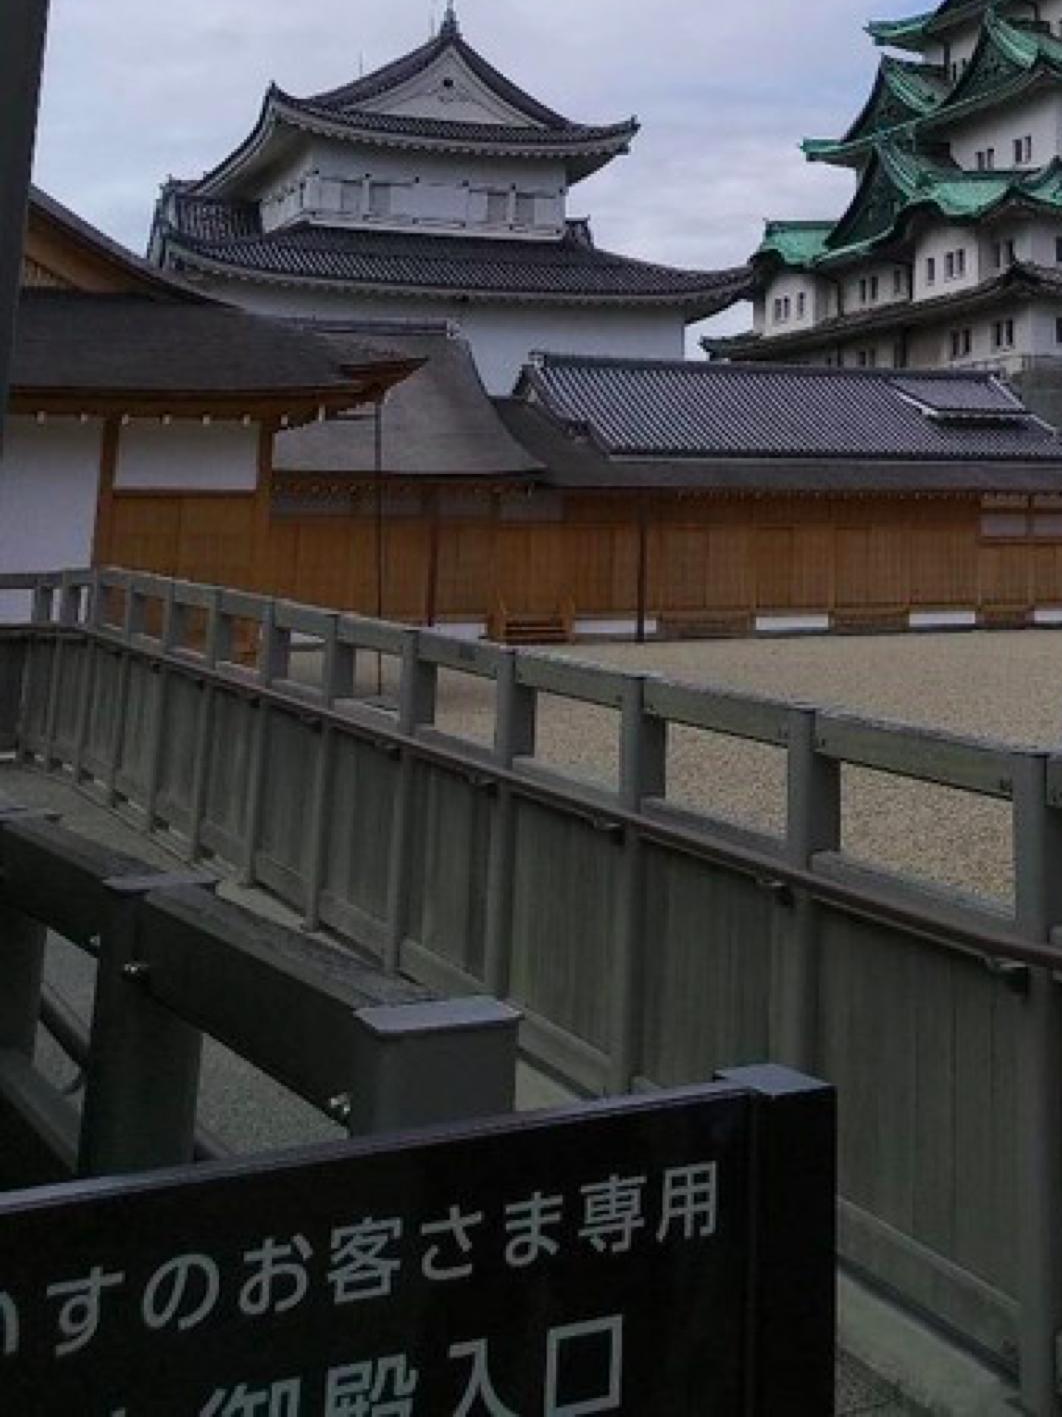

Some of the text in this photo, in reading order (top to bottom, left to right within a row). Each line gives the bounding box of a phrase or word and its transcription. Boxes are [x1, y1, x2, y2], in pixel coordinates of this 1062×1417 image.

[0, 1160, 718, 1359] すのお客さま専用
